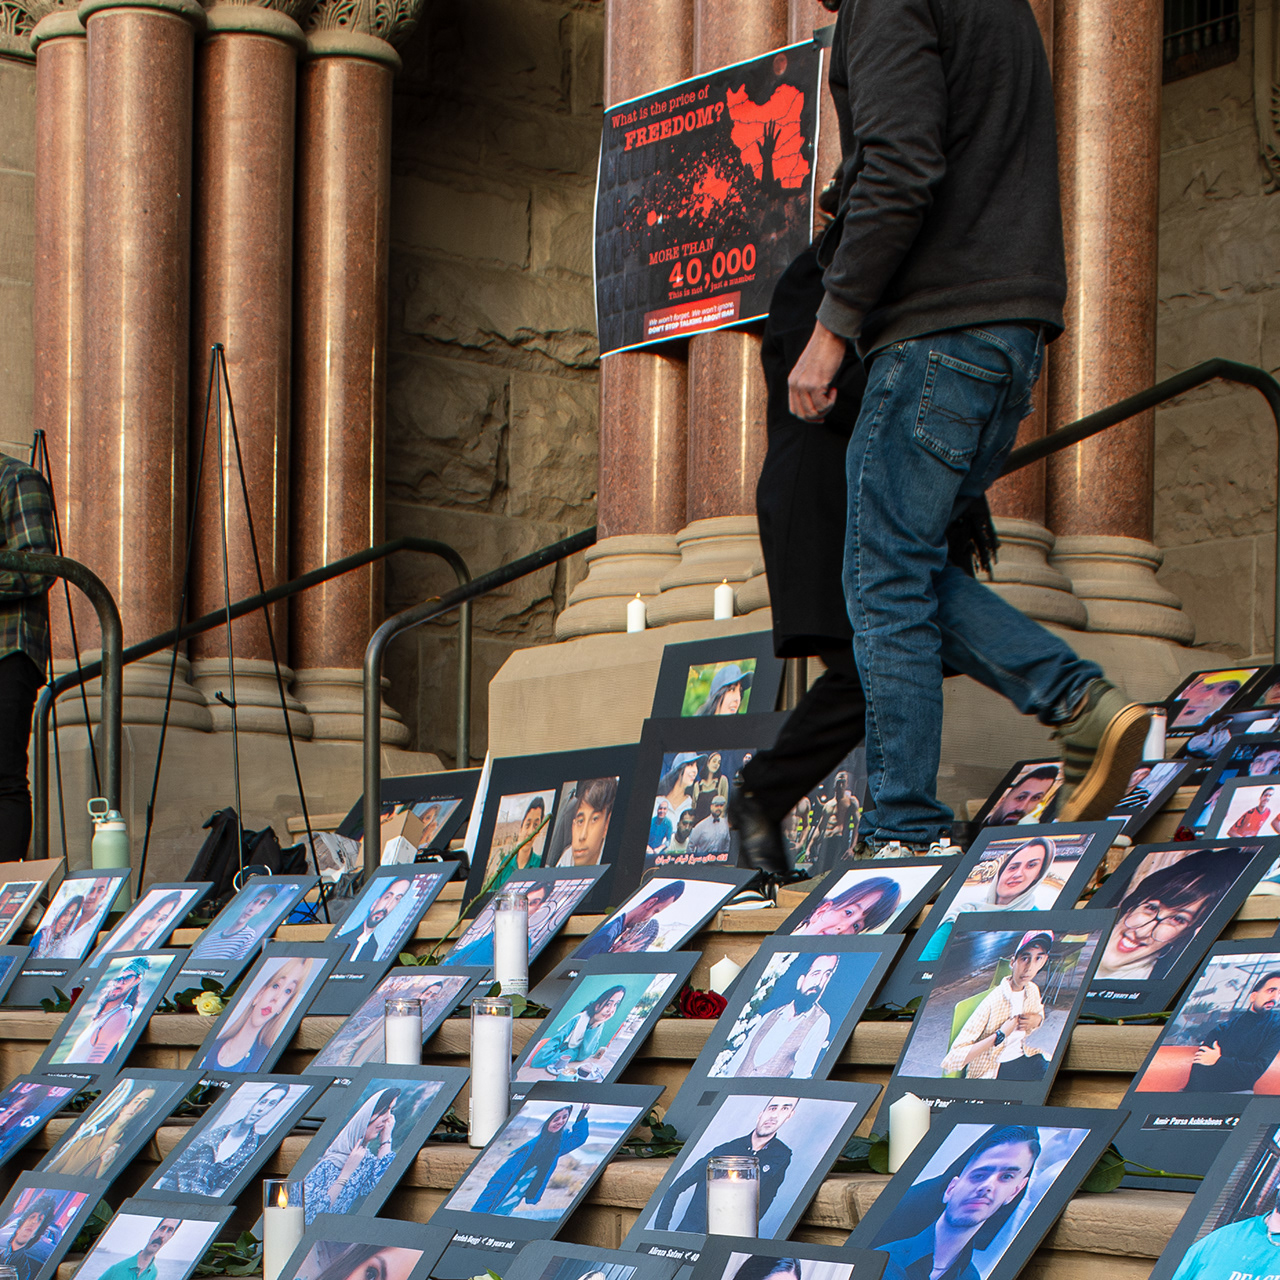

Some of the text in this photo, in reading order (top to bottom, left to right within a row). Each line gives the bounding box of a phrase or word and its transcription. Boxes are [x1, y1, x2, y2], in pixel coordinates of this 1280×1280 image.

[611, 84, 710, 128] What is the price of
[624, 101, 725, 152] FREEDOM?
[649, 237, 714, 266] MORE THAN
[669, 243, 756, 289] 40,000
[668, 289, 683, 300] This
[684, 287, 690, 297] is
[691, 285, 703, 295] not
[710, 281, 723, 293] just
[729, 273, 756, 286] number
[664, 321, 679, 331] STOP
[679, 316, 702, 328] TALKING
[703, 312, 721, 323] ABOUT
[721, 308, 734, 318] IRAN
